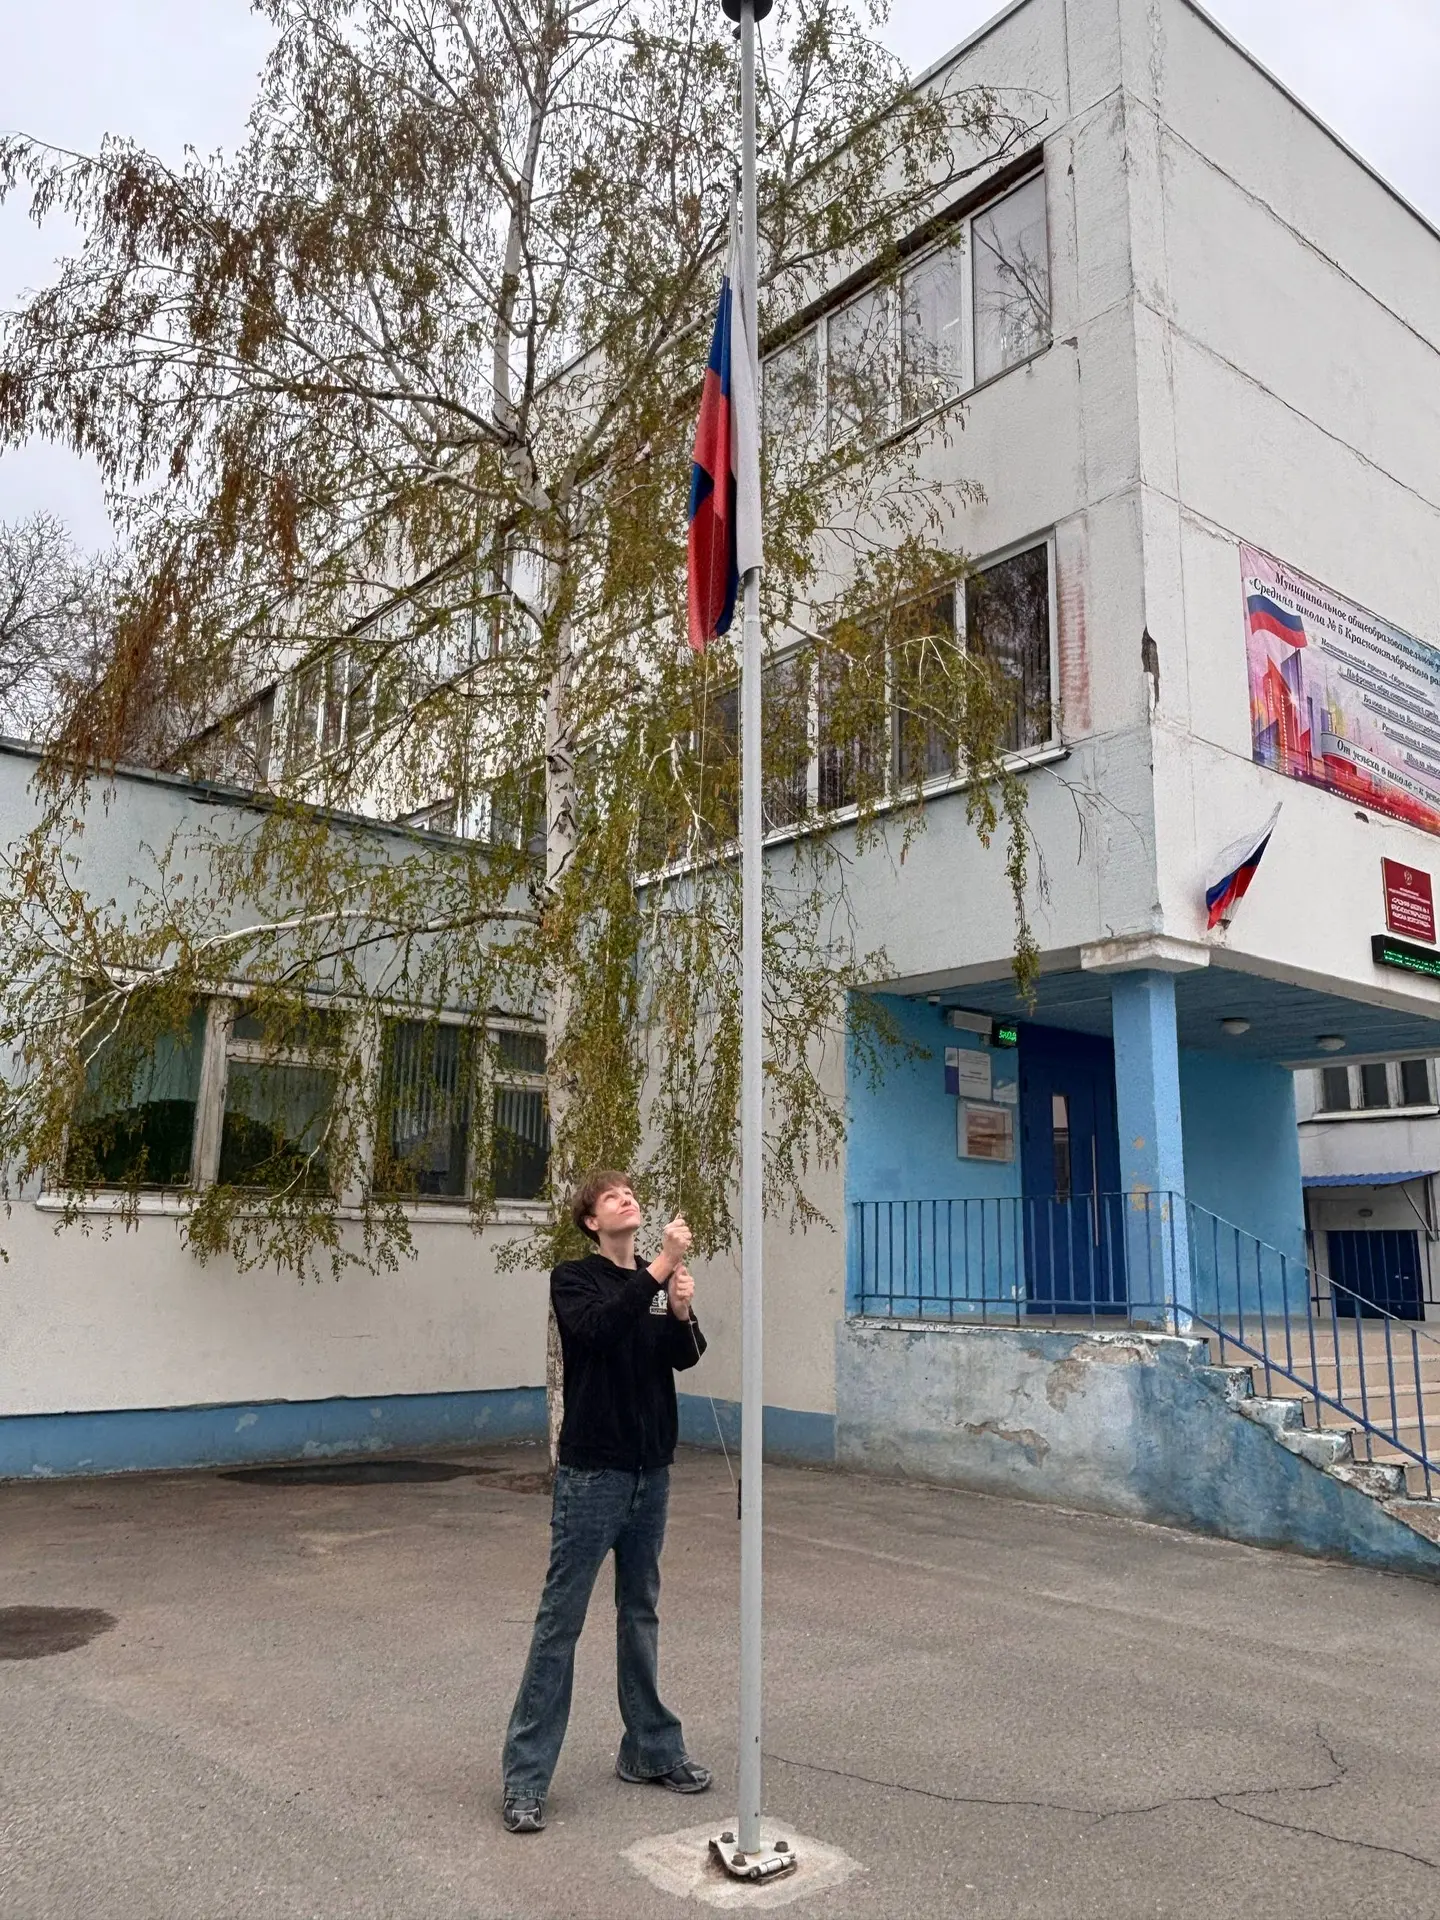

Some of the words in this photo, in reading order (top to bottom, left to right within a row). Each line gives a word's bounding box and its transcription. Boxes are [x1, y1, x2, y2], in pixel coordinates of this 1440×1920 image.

[1249, 578, 1294, 608] «Средняя
[1295, 603, 1325, 626] школа
[1325, 617, 1337, 632] №
[1338, 624, 1343, 636] 5
[1345, 627, 1428, 680] Краснооктябрьского
[1430, 675, 1440, 686] ра
[1275, 571, 1346, 620] Муниципальное
[1347, 614, 1434, 668] общеобразовательное
[1337, 739, 1351, 755] От
[1353, 751, 1380, 771] успеха
[1381, 764, 1386, 774] в
[1387, 769, 1412, 790] школе
